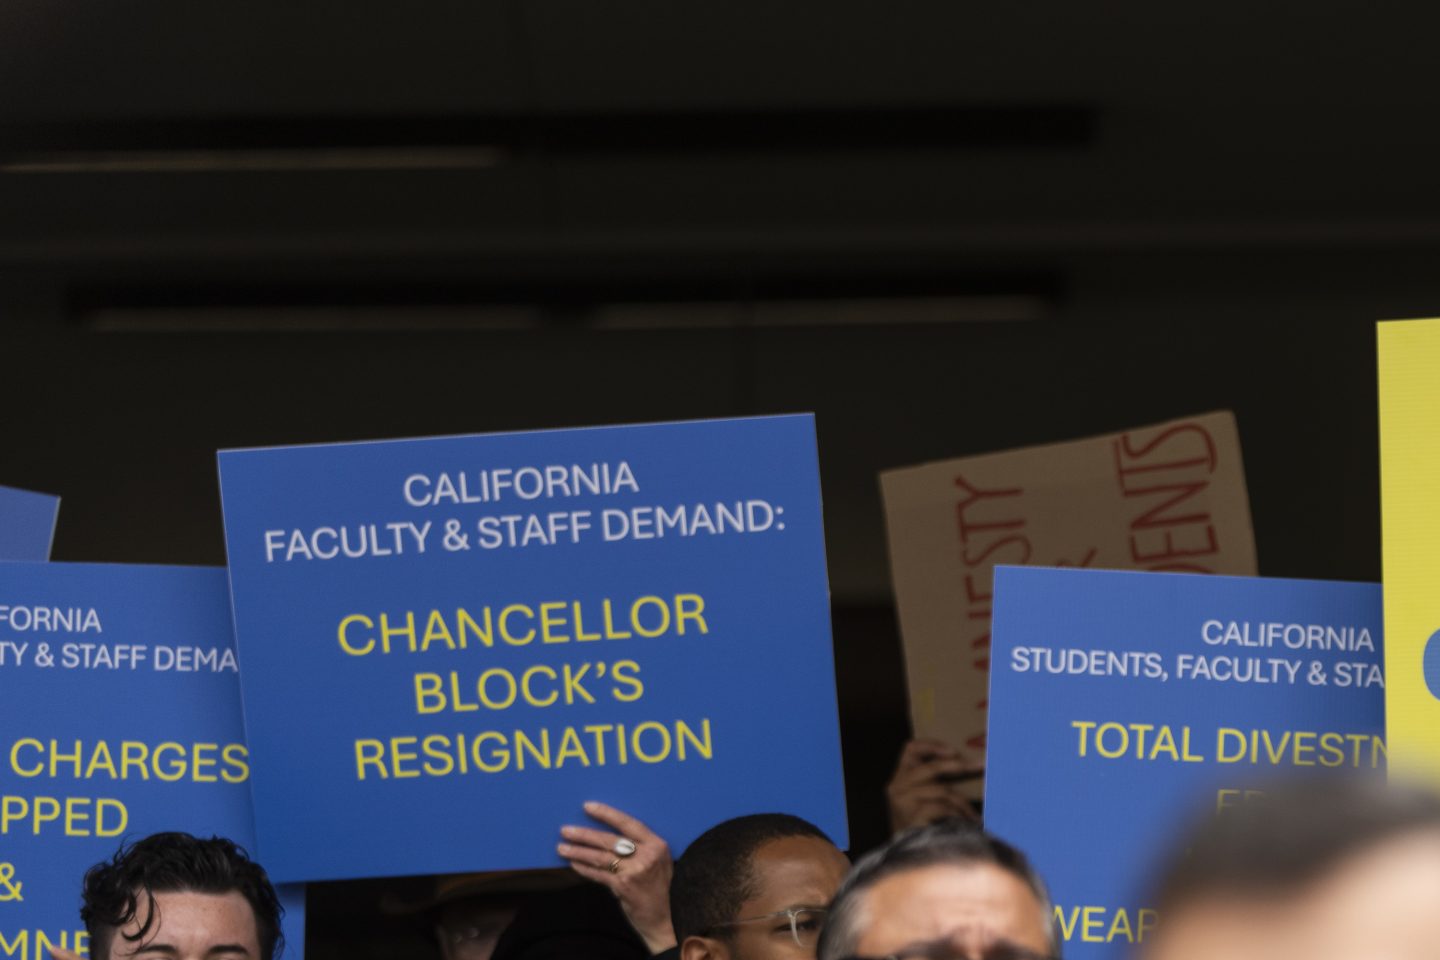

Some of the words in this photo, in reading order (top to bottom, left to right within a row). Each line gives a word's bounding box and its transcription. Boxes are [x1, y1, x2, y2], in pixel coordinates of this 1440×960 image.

[402, 460, 640, 508] CALIFORNIA
[263, 519, 432, 564] FACULTY
[441, 517, 471, 552] &
[477, 510, 592, 550] STAFF
[601, 500, 787, 543] DEMAND:
[336, 593, 710, 658] CHANCELLOR
[1201, 619, 1375, 653] CALIFORNIA
[34, 641, 55, 668] &
[61, 643, 148, 670] STAFF
[1010, 646, 1169, 683] STUDENTS,
[1177, 654, 1302, 686] FACULTY
[1306, 660, 1328, 686] &
[412, 660, 645, 716] BLOCK'S
[9, 737, 251, 784] CHARGES
[353, 718, 714, 782] RESIGNATION
[1071, 720, 1205, 763] TOTAL
[1, 796, 130, 838] PPED
